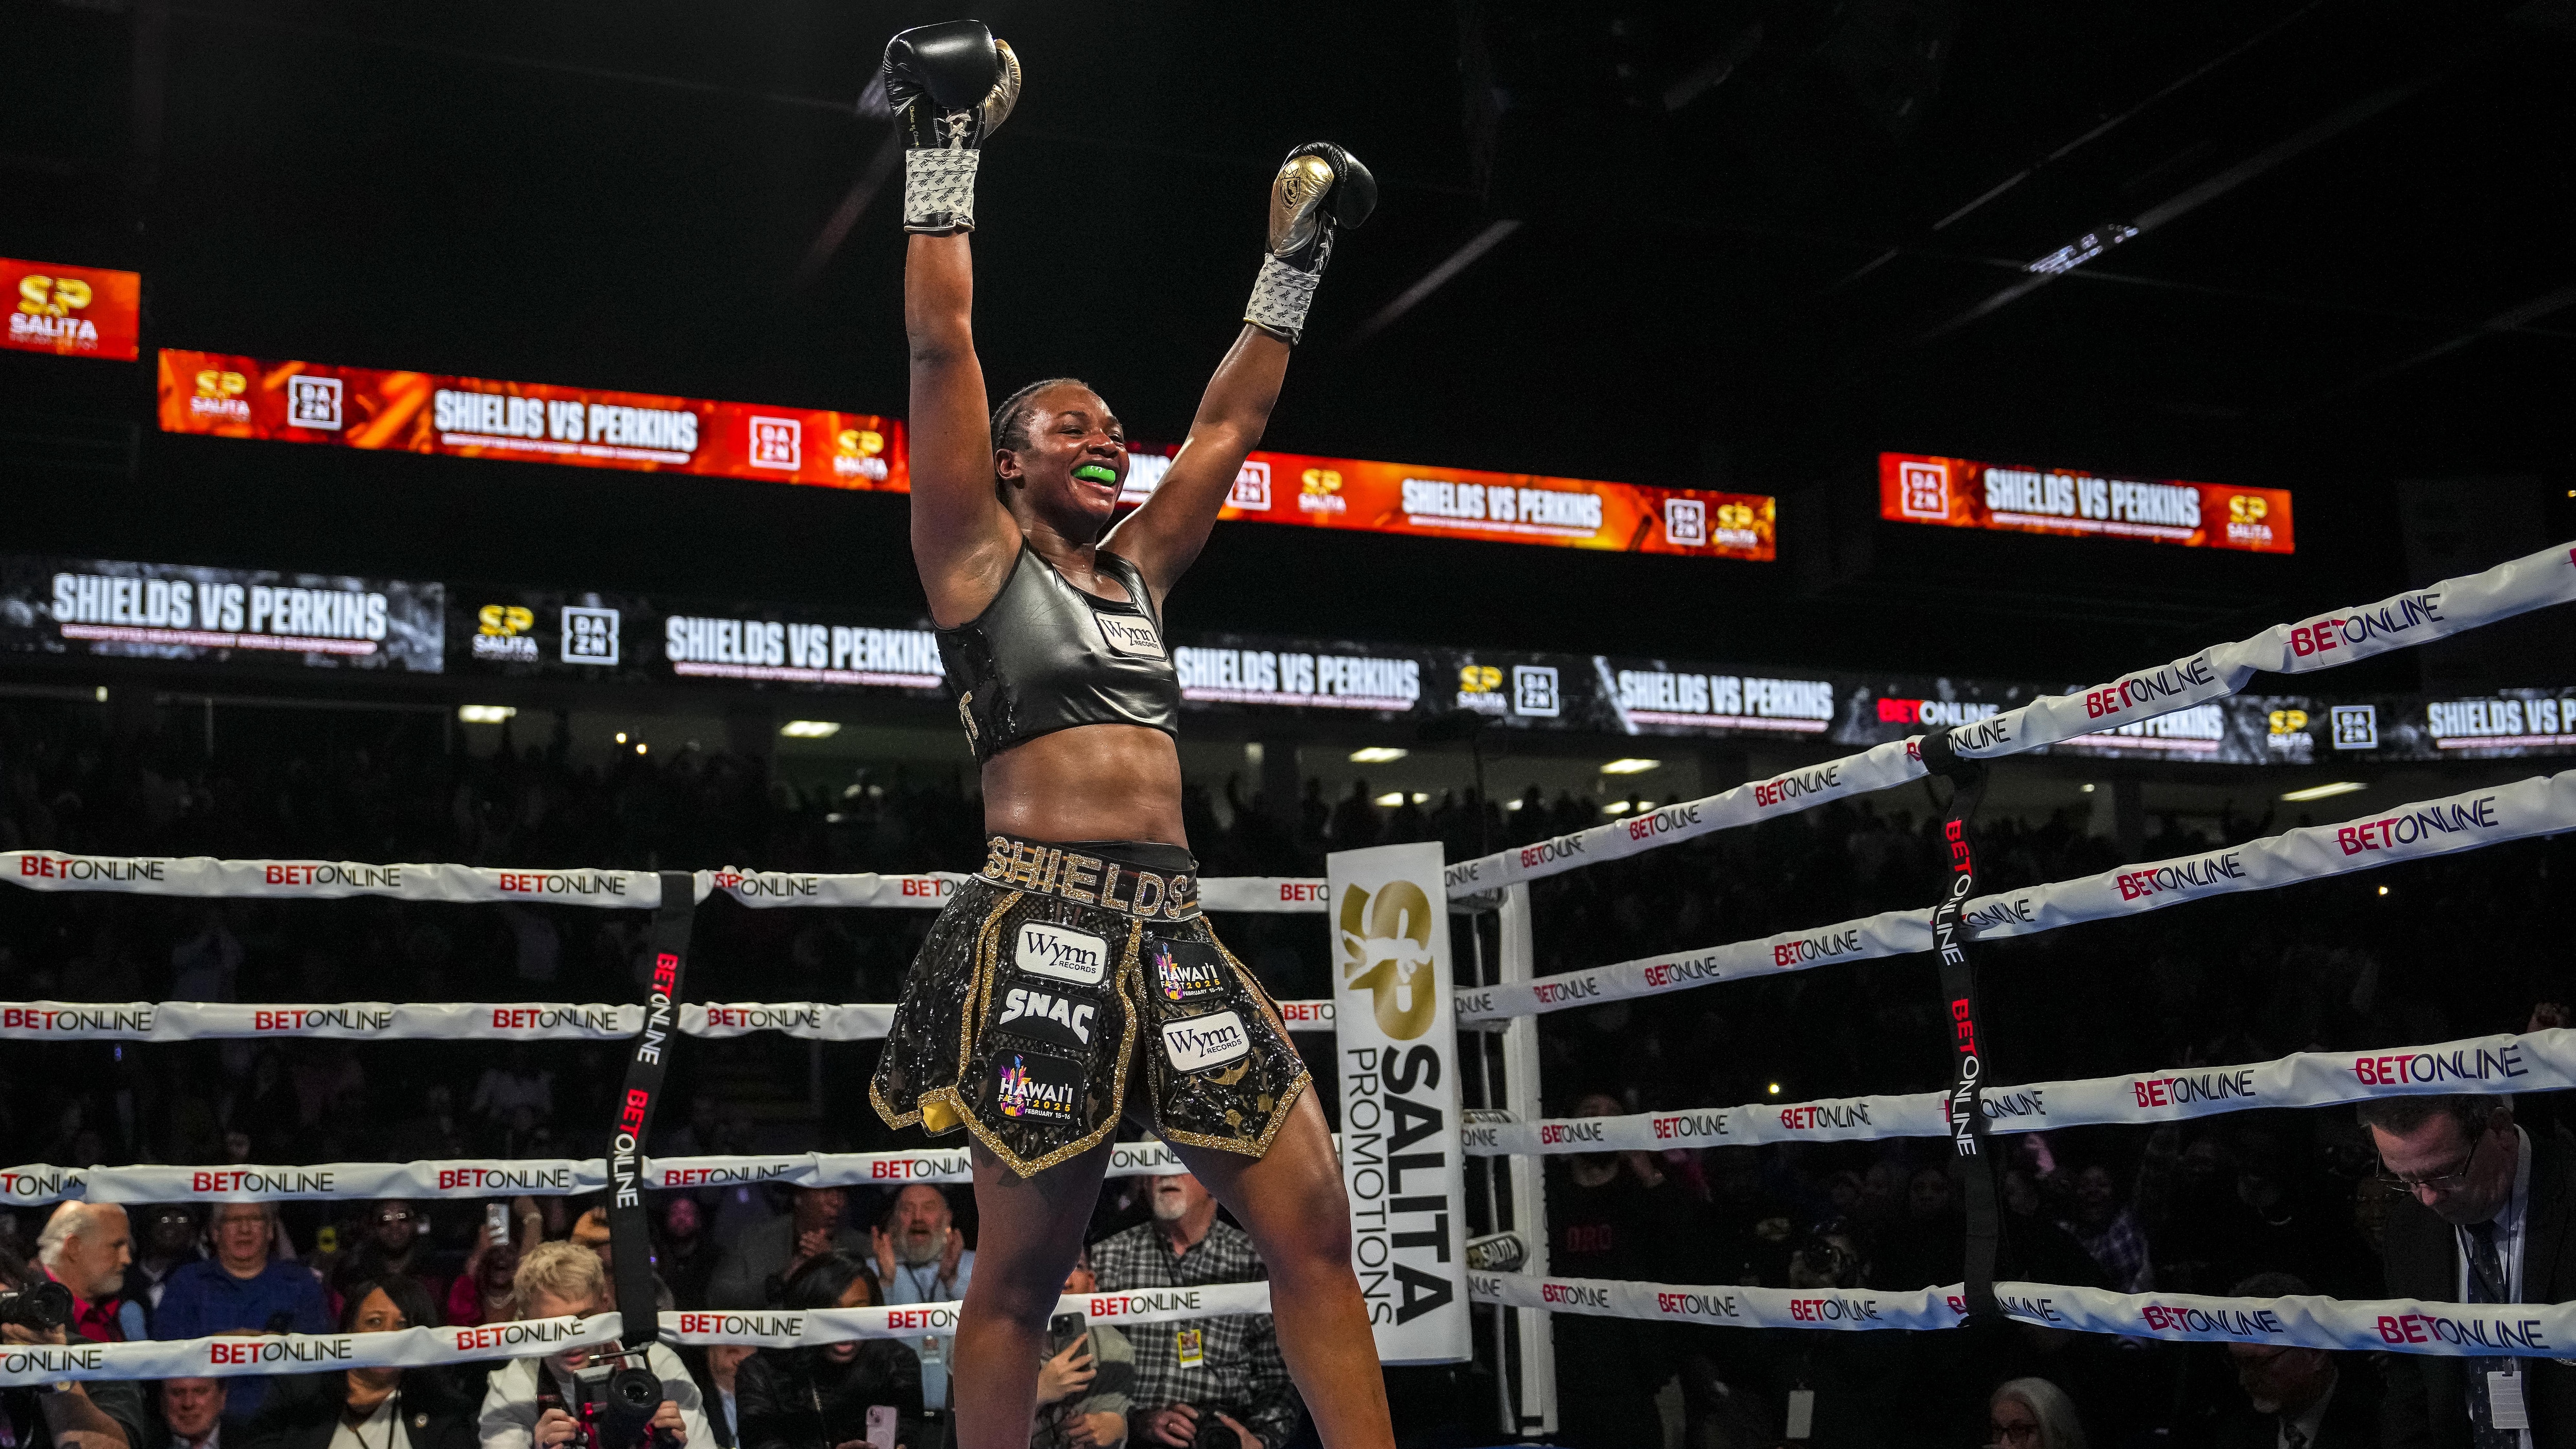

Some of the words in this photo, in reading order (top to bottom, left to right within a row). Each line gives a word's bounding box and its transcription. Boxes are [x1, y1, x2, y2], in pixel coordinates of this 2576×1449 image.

[1263, 303, 1274, 312] EVERLAST
[1277, 309, 1289, 318] EVERLAST
[9, 312, 98, 340] SALITA
[190, 396, 251, 418] SALITA
[435, 389, 545, 438] SHIELDS
[548, 400, 584, 441] VS
[588, 404, 699, 453] PERKINS
[834, 456, 889, 481] SALITA
[1401, 479, 1486, 521] SHIELDS
[1489, 486, 1516, 522] VS
[1518, 488, 1602, 530] PERKINS
[1985, 468, 2075, 517] SHIELDS
[2077, 478, 2109, 519] VS
[2110, 480, 2201, 527] PERKINS
[2227, 522, 2273, 540] SALITA
[53, 573, 192, 628] SHIELDS
[198, 582, 244, 632] VS
[251, 585, 388, 641] PERKINS
[1100, 618, 1157, 646] Wynn
[2284, 593, 2444, 657] BETONLINE
[472, 635, 538, 655] SALITA
[666, 615, 786, 667] SHIELDS
[788, 624, 827, 669] VS
[1134, 640, 1159, 649] RECORDS
[1174, 646, 1277, 691] SHIELDS
[1279, 652, 1315, 693] VS
[1317, 655, 1420, 701] PERKINS
[2081, 657, 2215, 718] BETONLINE
[1618, 670, 1709, 713] SHIELDS
[1710, 675, 1742, 715] VS
[1743, 677, 1834, 720] PERKINS
[2427, 700, 2523, 738] SHIELDS
[2525, 698, 2560, 736] VS
[1754, 765, 1841, 807] BETONLINE
[1629, 804, 1702, 840] BETONLINE
[2332, 796, 2499, 856] BETONLINE
[21, 856, 165, 881] BETONLINE
[265, 865, 401, 887] BETONLINE
[985, 836, 1188, 919] SHIELDS
[2111, 852, 2246, 901] BETONLINE
[500, 874, 626, 896] BETONLINE
[1937, 818, 1973, 966] BETONLINE
[1026, 931, 1098, 966] Wynn
[1771, 929, 1862, 966] BETONLINE
[1059, 960, 1096, 974] RECORDS
[1645, 957, 1720, 987] BETONLINE
[1186, 979, 1221, 989] 2025
[4, 1008, 151, 1031] BETONLINE
[255, 1009, 392, 1030] BETONLINE
[493, 1009, 618, 1030] BETONLINE
[637, 952, 679, 1065] BETONLINE
[708, 1008, 820, 1028] BETONLINE
[999, 988, 1095, 1045] SNAC
[1167, 1024, 1240, 1058] Wynn
[1207, 1038, 1242, 1054] RECORDS
[1952, 998, 1979, 1156] BETONLINE
[2348, 1045, 2529, 1085] BETONLINE
[2129, 1069, 2256, 1108] BETONLINE
[997, 1094, 1031, 1106] FEST
[1033, 1100, 1071, 1112] 2025
[1025, 1108, 1053, 1117] FEBRUARY
[1779, 1103, 1872, 1130] BETONLINE
[1653, 1115, 1729, 1139] BETONLINE
[613, 1088, 649, 1209] BETONLINE
[1111, 1141, 1181, 1168] ONLINE
[193, 1171, 334, 1191] BETONLINE
[439, 1168, 570, 1189] BETONLINE
[1347, 1047, 1393, 1326] PROMOTIONS
[1381, 1044, 1452, 1326] SALITA
[1091, 1292, 1201, 1317] BETONLINE
[1658, 1292, 1739, 1318] BETONLINE
[1787, 1299, 1883, 1322] BETONLINE
[681, 1314, 803, 1336] BETONLINE
[888, 1309, 959, 1329] BETON
[2137, 1305, 2284, 1334] BETONLINE
[2371, 1315, 2551, 1350] BETONLINE
[456, 1320, 586, 1350] BETONLINE
[0, 1349, 103, 1373] ONLINE
[211, 1339, 352, 1363] BETONLINE
